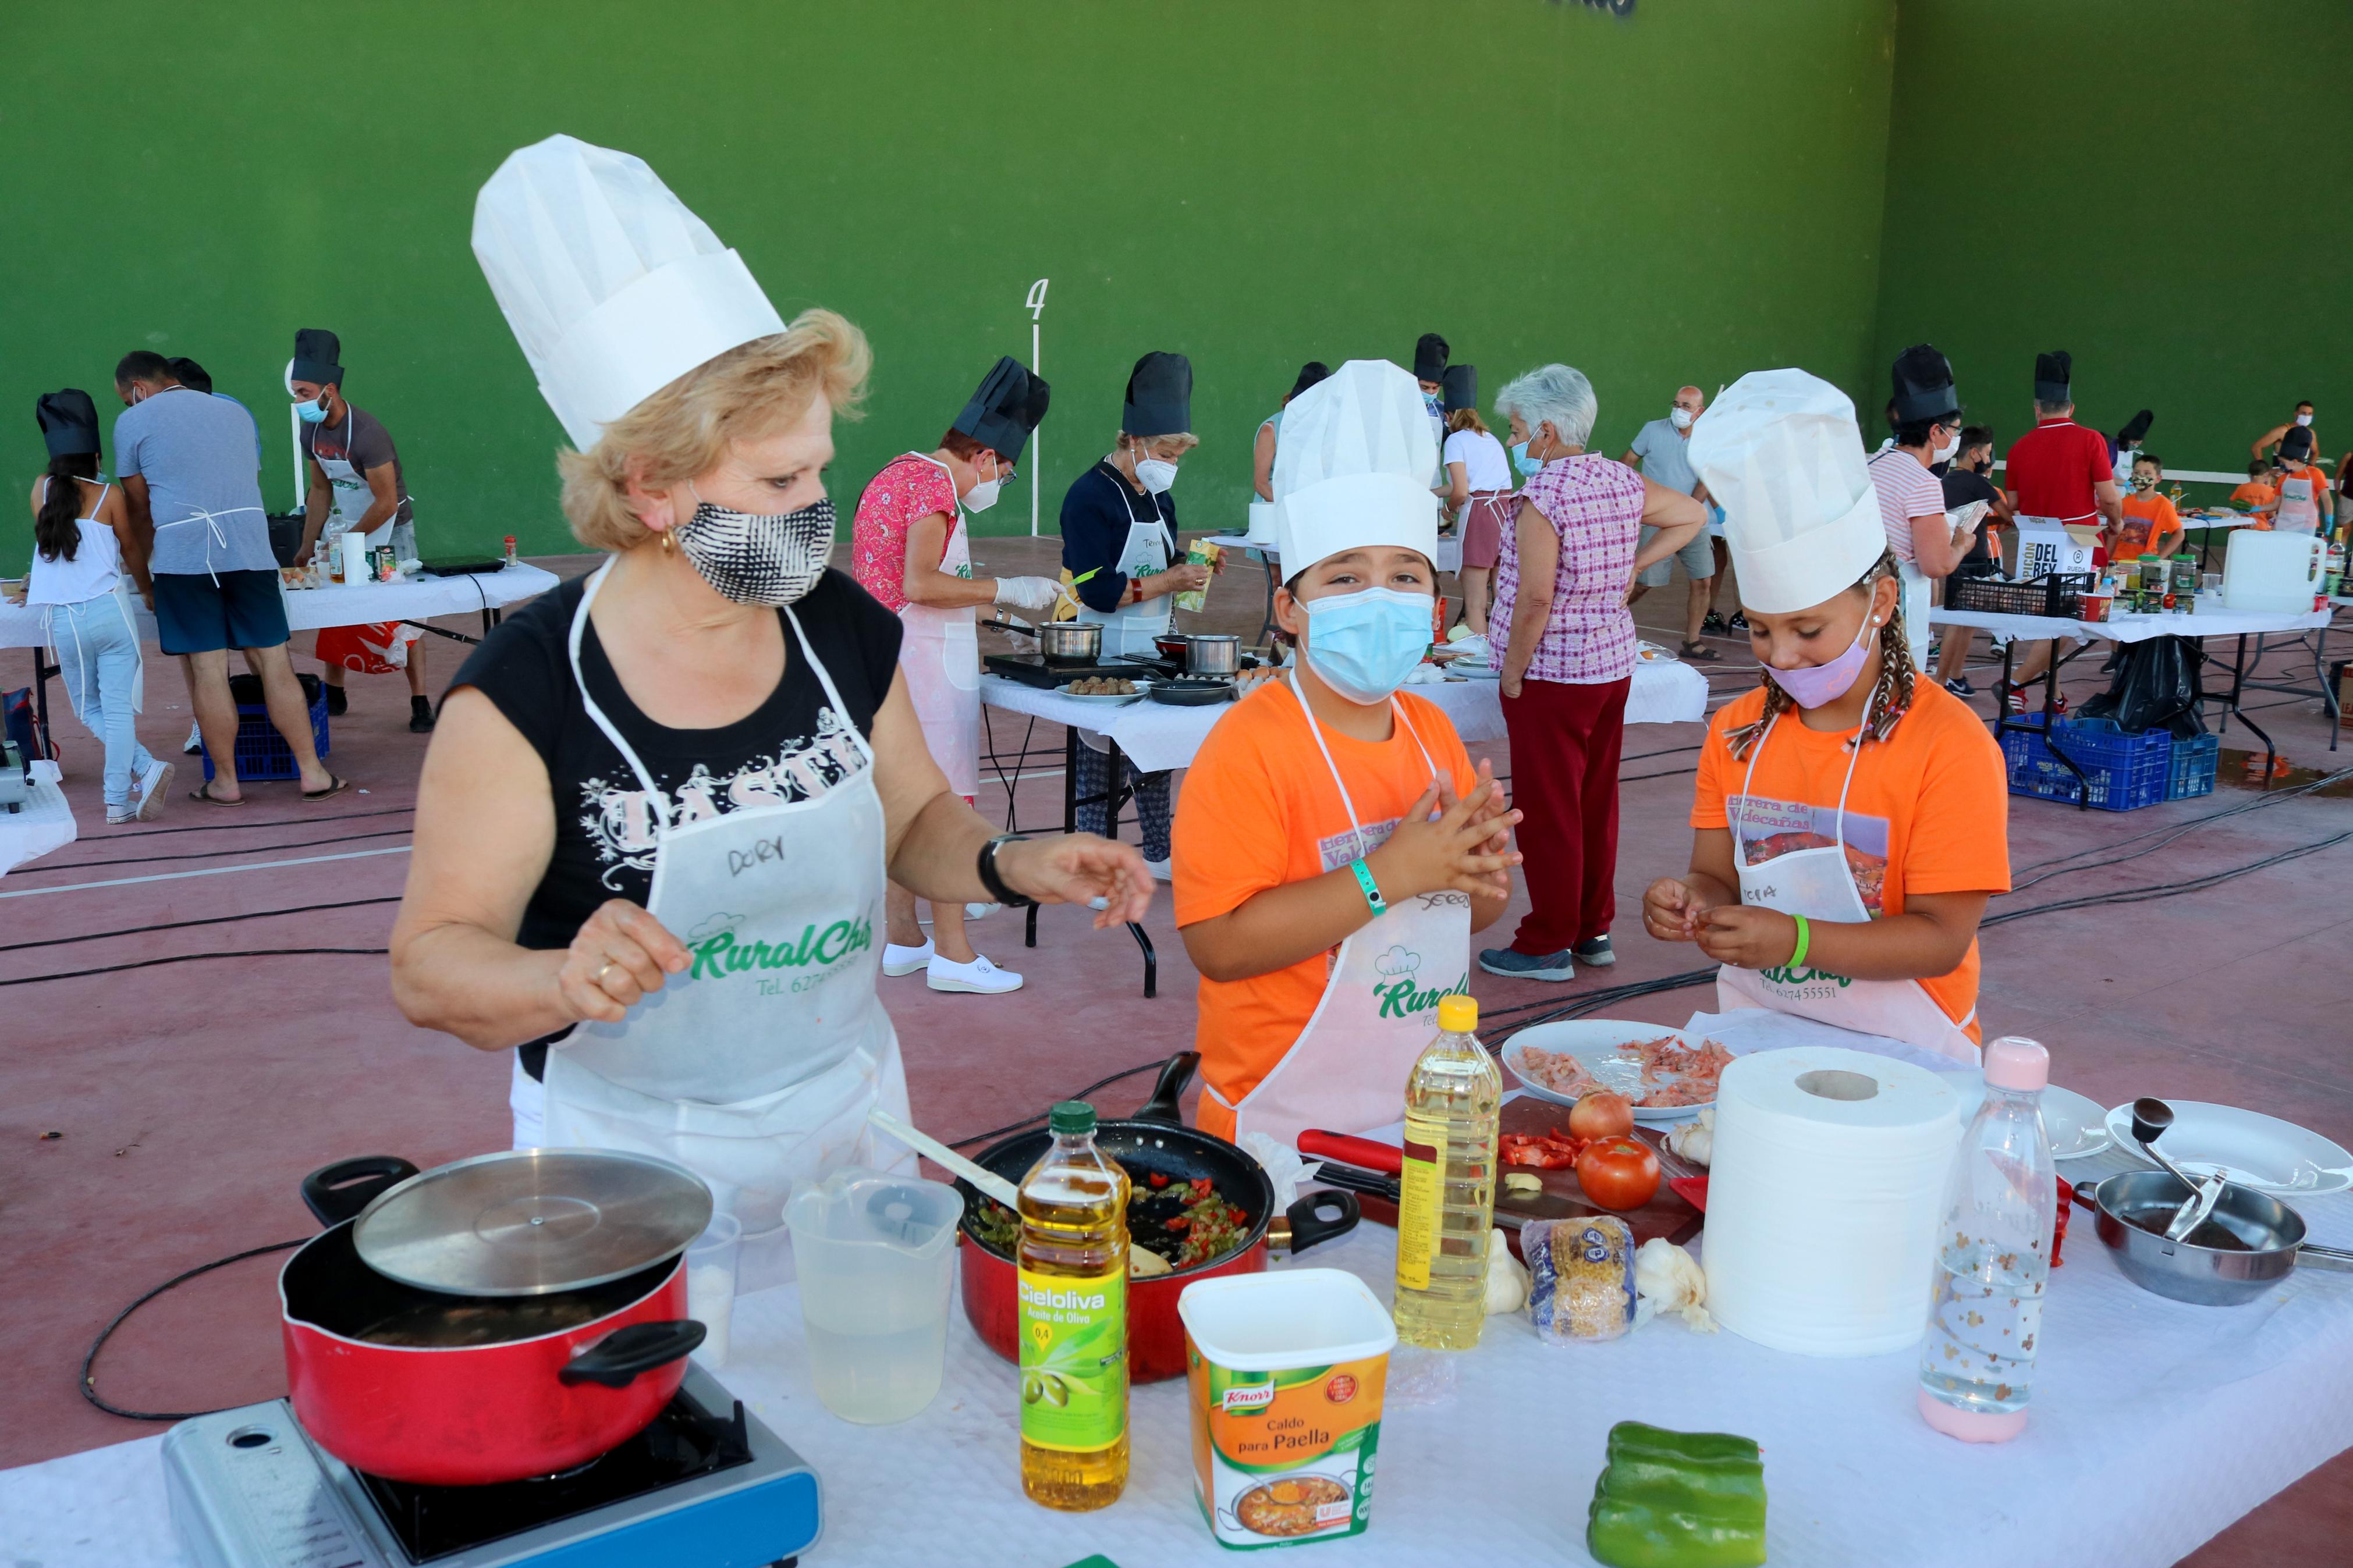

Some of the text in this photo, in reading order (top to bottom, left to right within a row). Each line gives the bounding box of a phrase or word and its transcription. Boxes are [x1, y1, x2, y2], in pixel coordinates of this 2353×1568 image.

[1025, 278, 1049, 319] 4
[2022, 542, 2036, 577] PICÓN
[2035, 543, 2058, 563] DEL
[2032, 562, 2057, 580] REY
[1787, 802, 1808, 813] de
[728, 835, 785, 877] DORY
[1019, 1279, 1105, 1310] Cieloliva
[1027, 1306, 1090, 1324] Aceite de Oliva
[1035, 1327, 1049, 1340] 0,4
[1227, 1390, 1270, 1403] Knorr
[1267, 1417, 1304, 1431] Caldo
[1238, 1443, 1268, 1453] para
[1274, 1429, 1329, 1449] Paella
